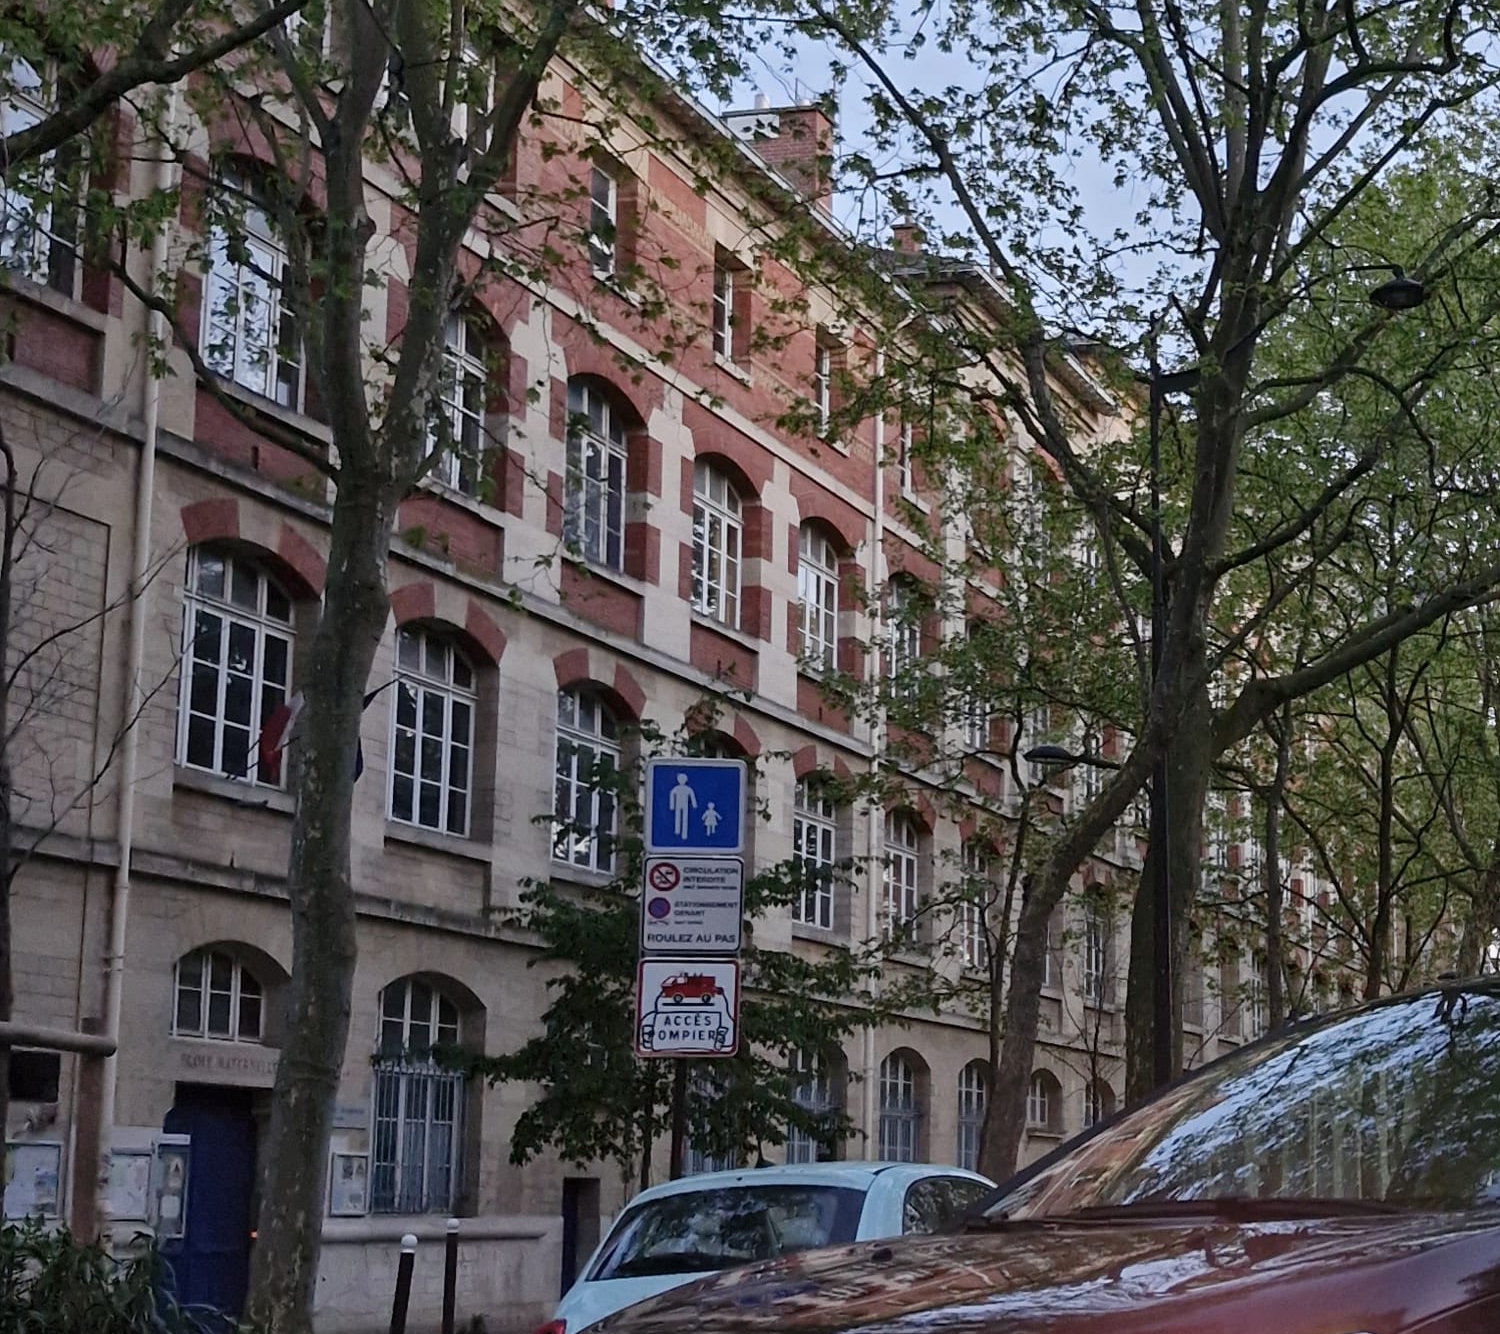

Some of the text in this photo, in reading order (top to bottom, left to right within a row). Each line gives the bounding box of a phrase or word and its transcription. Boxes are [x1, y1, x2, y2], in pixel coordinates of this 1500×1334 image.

[647, 933, 736, 944] ROULEZ AU PAS
[664, 1012, 712, 1027] ACCÈS
